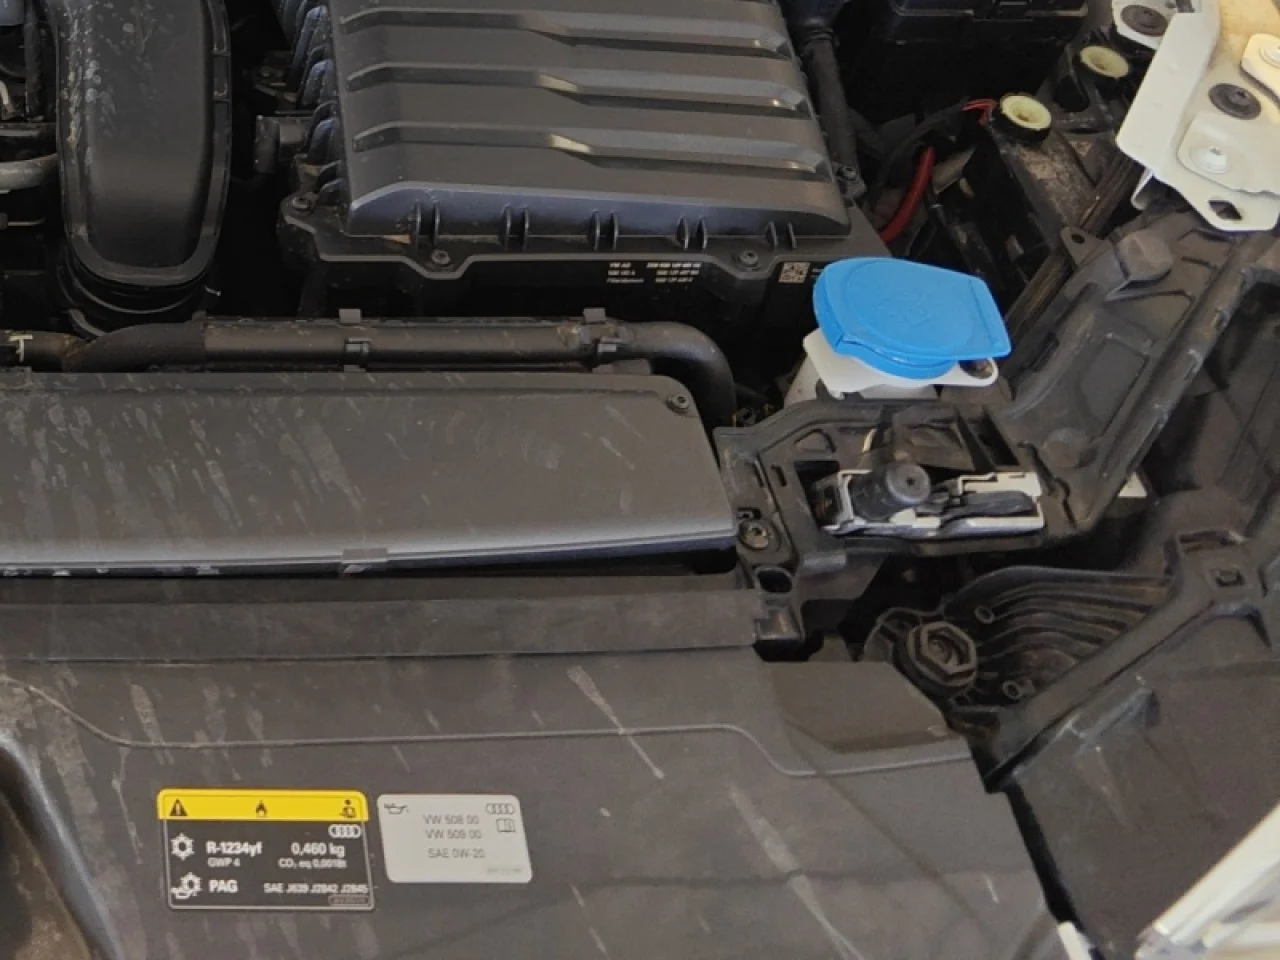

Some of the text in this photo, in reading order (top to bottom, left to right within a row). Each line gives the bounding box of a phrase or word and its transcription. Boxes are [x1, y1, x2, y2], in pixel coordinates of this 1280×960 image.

[423, 814, 442, 825] VW
[466, 814, 480, 825] 00
[425, 829, 444, 839] VW
[469, 829, 482, 839] 00
[206, 841, 263, 858] R-1234yf
[328, 842, 346, 858] kg
[428, 847, 486, 859] SAE 0W-20
[208, 879, 239, 893] PAG
